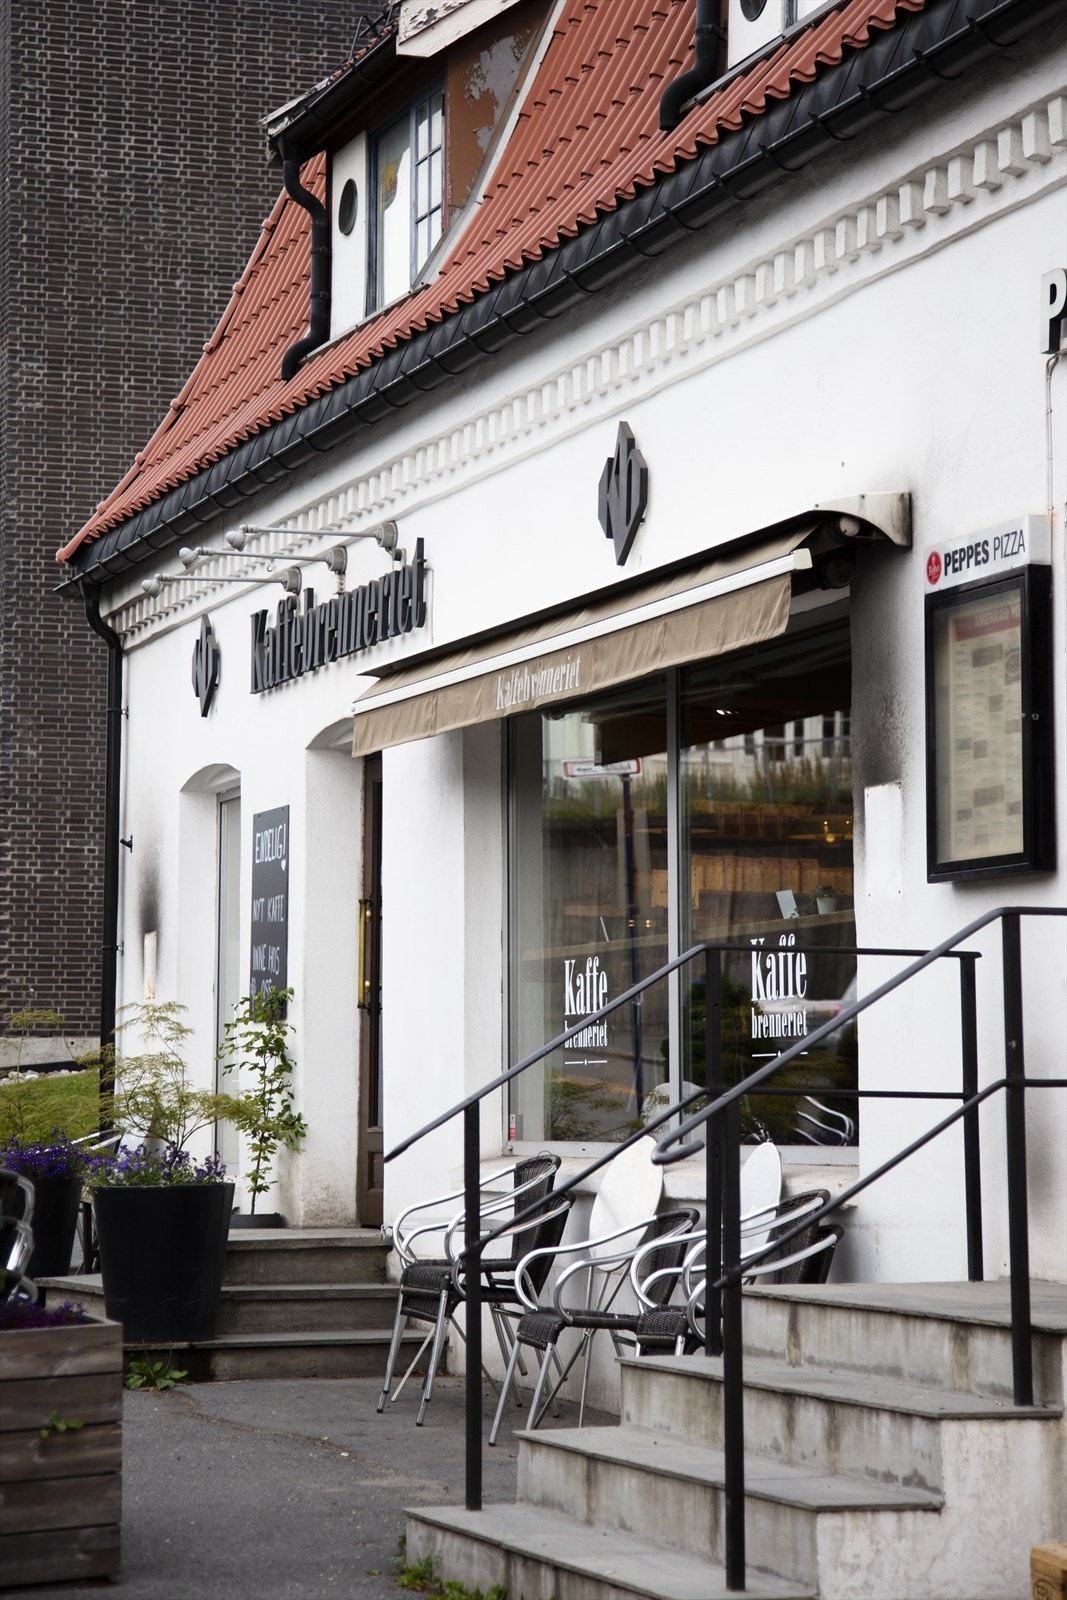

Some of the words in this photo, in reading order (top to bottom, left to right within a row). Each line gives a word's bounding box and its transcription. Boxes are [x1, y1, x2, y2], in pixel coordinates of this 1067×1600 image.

[944, 540, 989, 576] PEPPES
[993, 529, 1026, 561] PIZZA
[250, 537, 426, 694] Kaffebrenneriet
[255, 823, 287, 865] ENDELIG!
[267, 894, 284, 922] KAFFE
[564, 956, 608, 1015] Kaffe
[750, 933, 807, 1002] Kaffe
[751, 1005, 808, 1039] brenneriet
